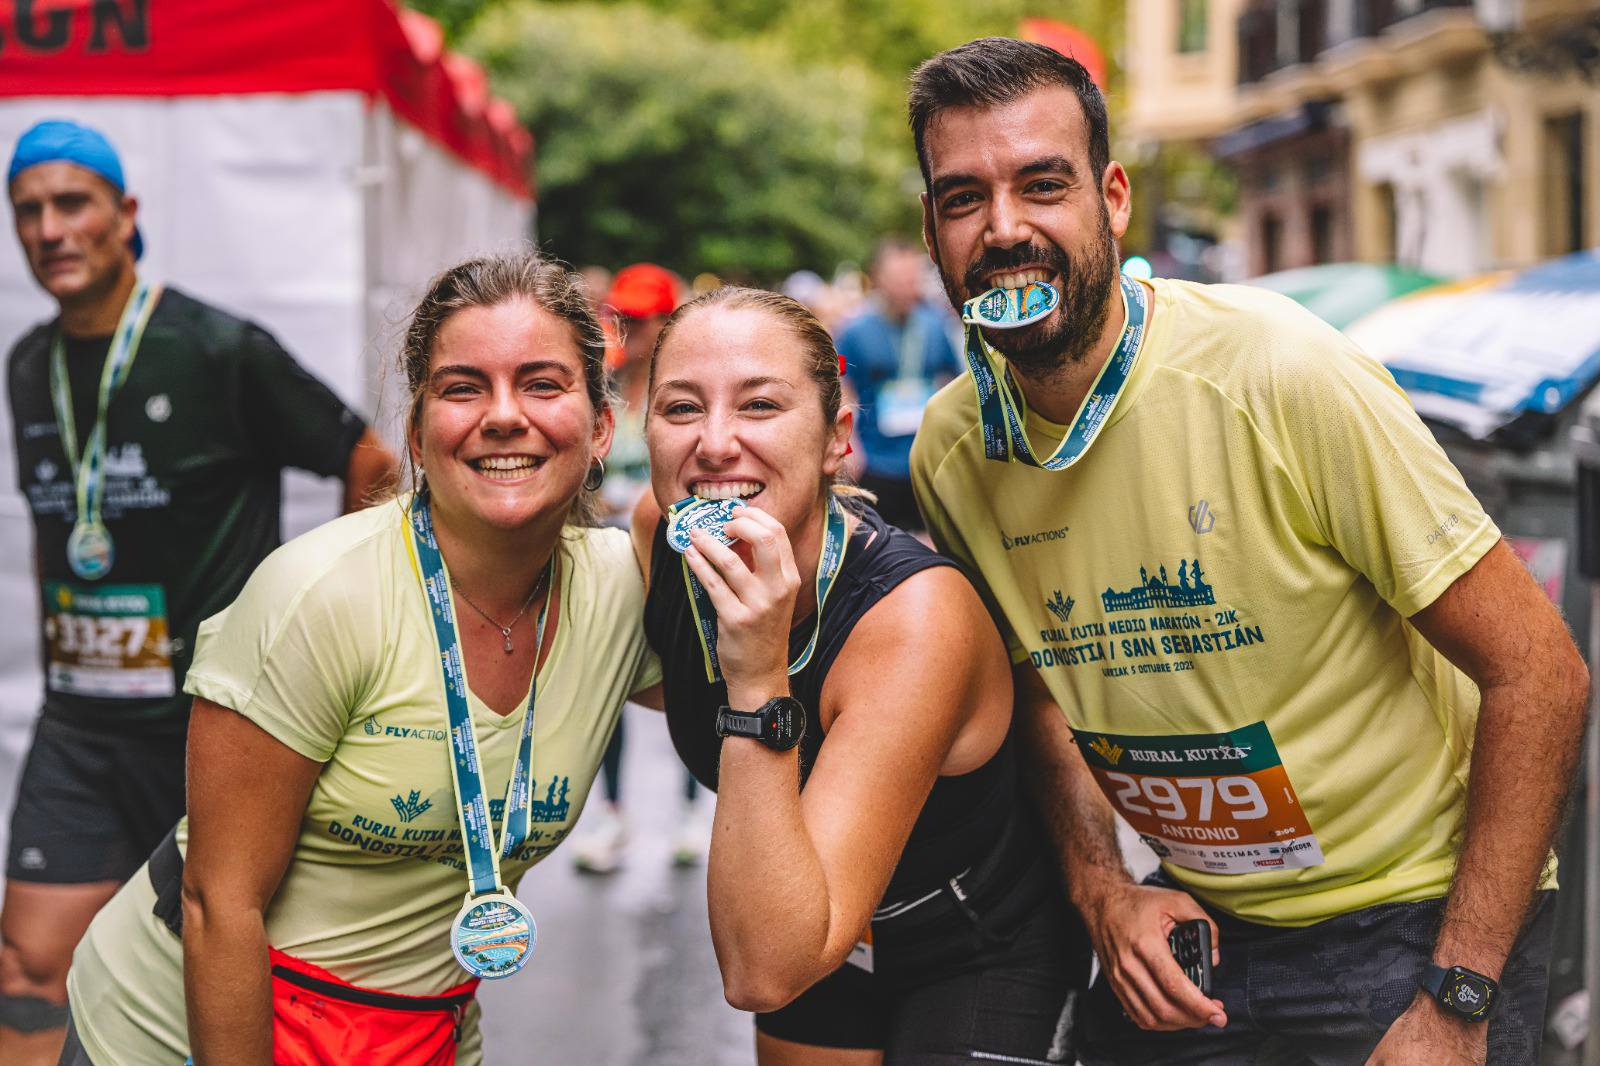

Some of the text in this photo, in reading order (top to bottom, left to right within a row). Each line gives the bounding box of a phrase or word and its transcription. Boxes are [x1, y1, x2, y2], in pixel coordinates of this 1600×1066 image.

[1041, 628, 1069, 642] RURAL
[1070, 623, 1106, 640] KUTXA
[1109, 618, 1146, 634] MEDIO
[1150, 613, 1201, 630] MARATÓN
[1215, 610, 1239, 626] 21K
[1030, 642, 1106, 668] DONOSTIA
[1121, 637, 1157, 657] SAN
[1160, 624, 1265, 654] SEBASTIÁN
[1139, 663, 1171, 674] OCTUBRE
[1129, 746, 1248, 763] RURAL KUTXA
[1106, 771, 1268, 821] 2979
[328, 820, 427, 857] DONOSTIA
[352, 815, 397, 839] RURAL
[402, 828, 446, 842] KUTXA
[1162, 823, 1239, 841] ANTONIO
